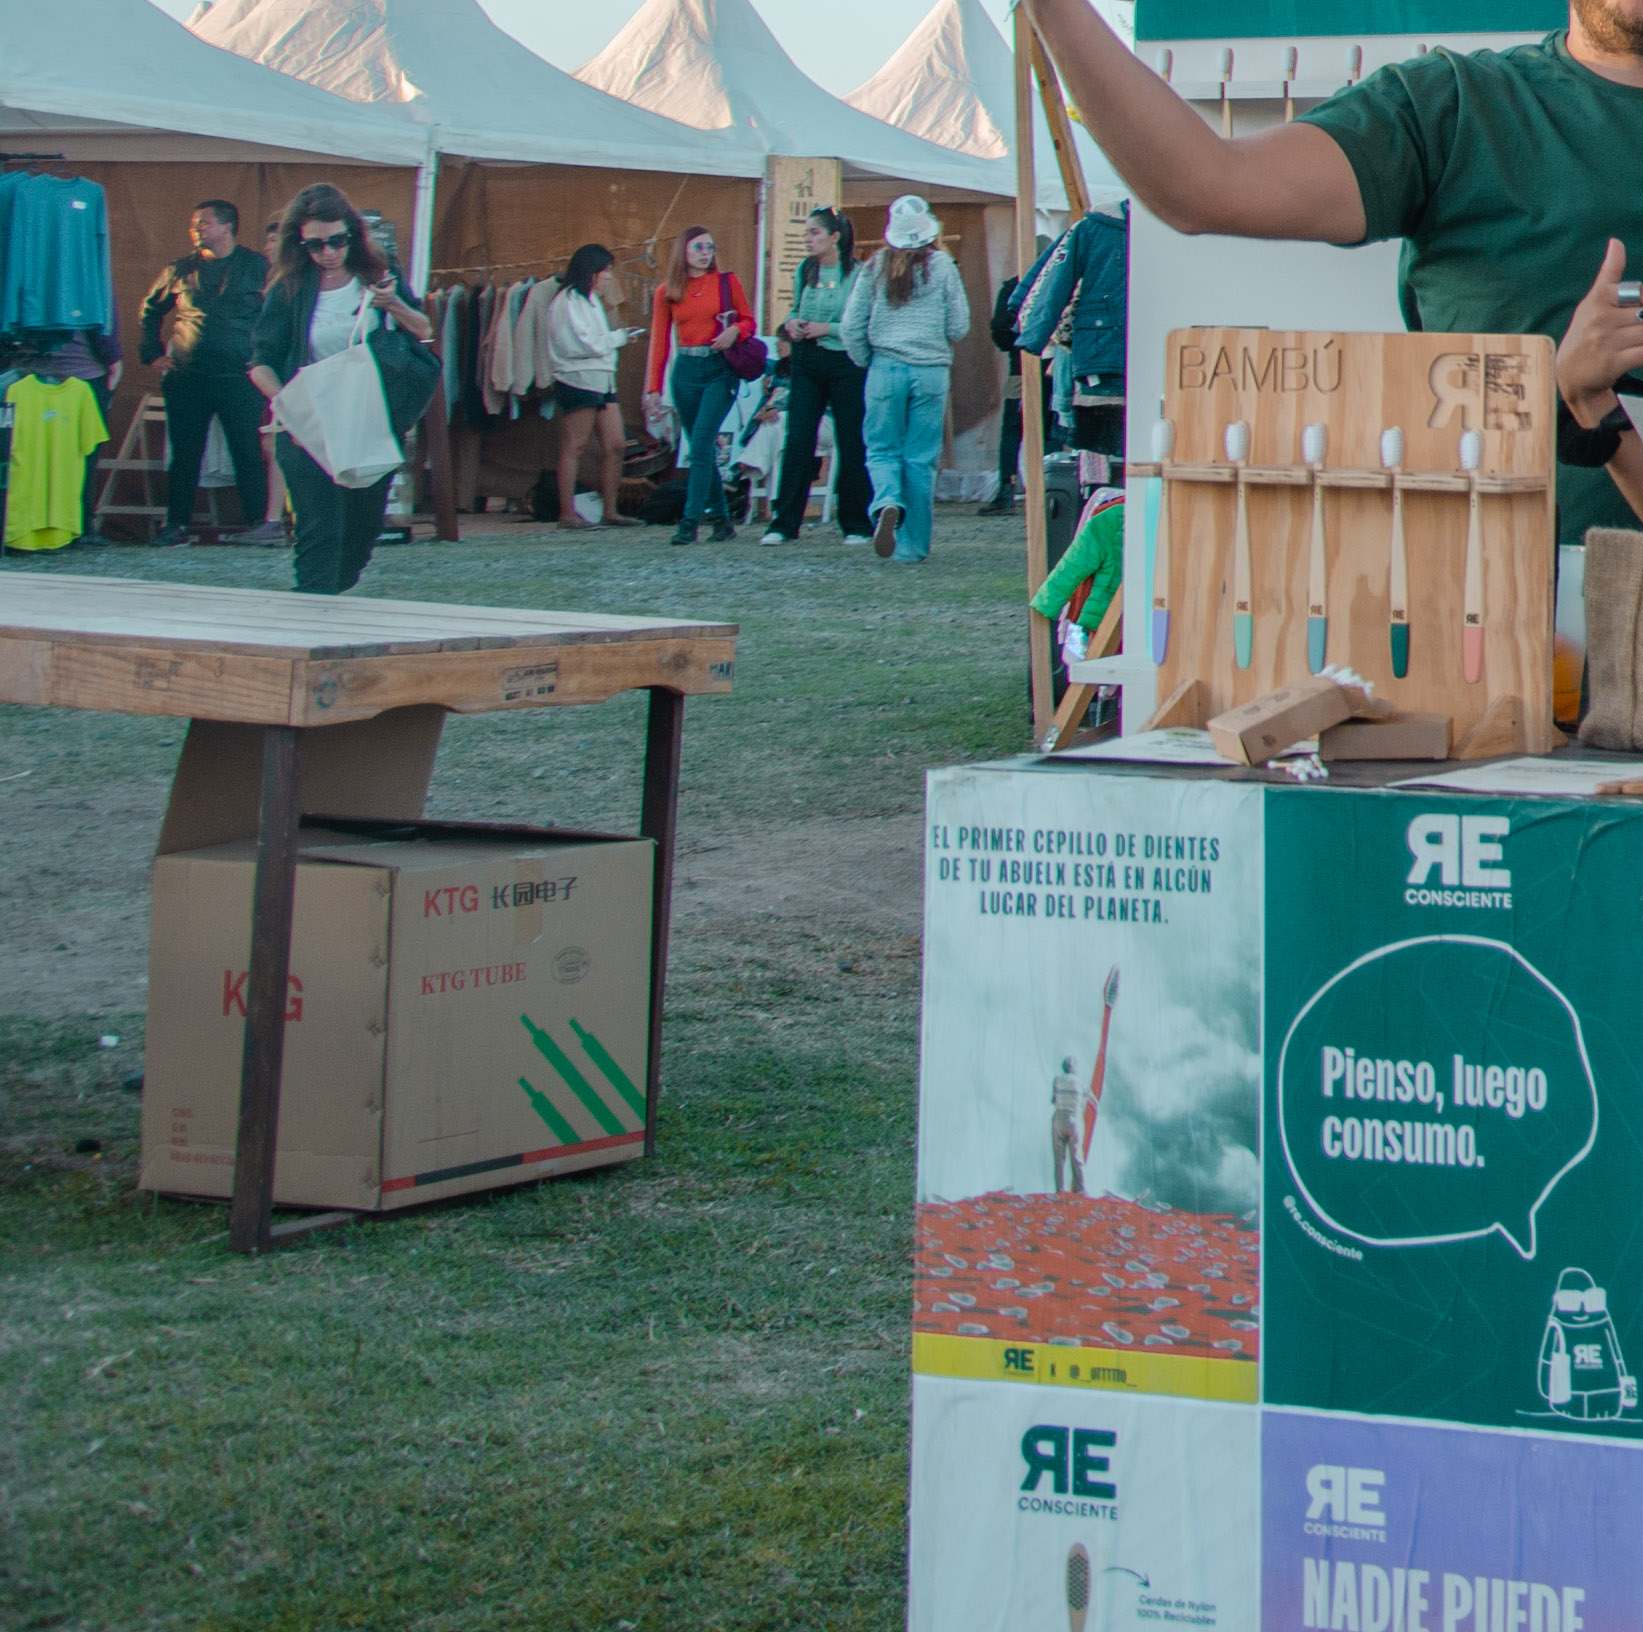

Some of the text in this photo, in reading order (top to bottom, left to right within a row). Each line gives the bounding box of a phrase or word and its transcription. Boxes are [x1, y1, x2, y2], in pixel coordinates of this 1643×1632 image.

[1178, 339, 1343, 394] BAMBÚ
[932, 825, 1220, 862] EL PRIMER CEPILLO DE DIENTES
[940, 857, 1212, 894] DE TU ABUELX ESTÁ EN ALGÚN
[424, 885, 478, 918] KTG
[980, 891, 1169, 924] LUGAR DEL PLANETA.
[1404, 889, 1513, 909] CONSCIENTE
[421, 970, 466, 995] KTG
[470, 962, 528, 988] TUBE
[223, 970, 304, 1022] KG
[1321, 1046, 1548, 1119] Pienso, luego
[1322, 1116, 1485, 1168] consumo.
[1018, 1496, 1119, 1521] CONSCIENTE
[1303, 1522, 1387, 1543] CONSCIENTE
[1174, 1598, 1186, 1610] de
[1303, 1557, 1586, 1632] NADIE PUEDE
[1136, 1608, 1161, 1621] 100%
